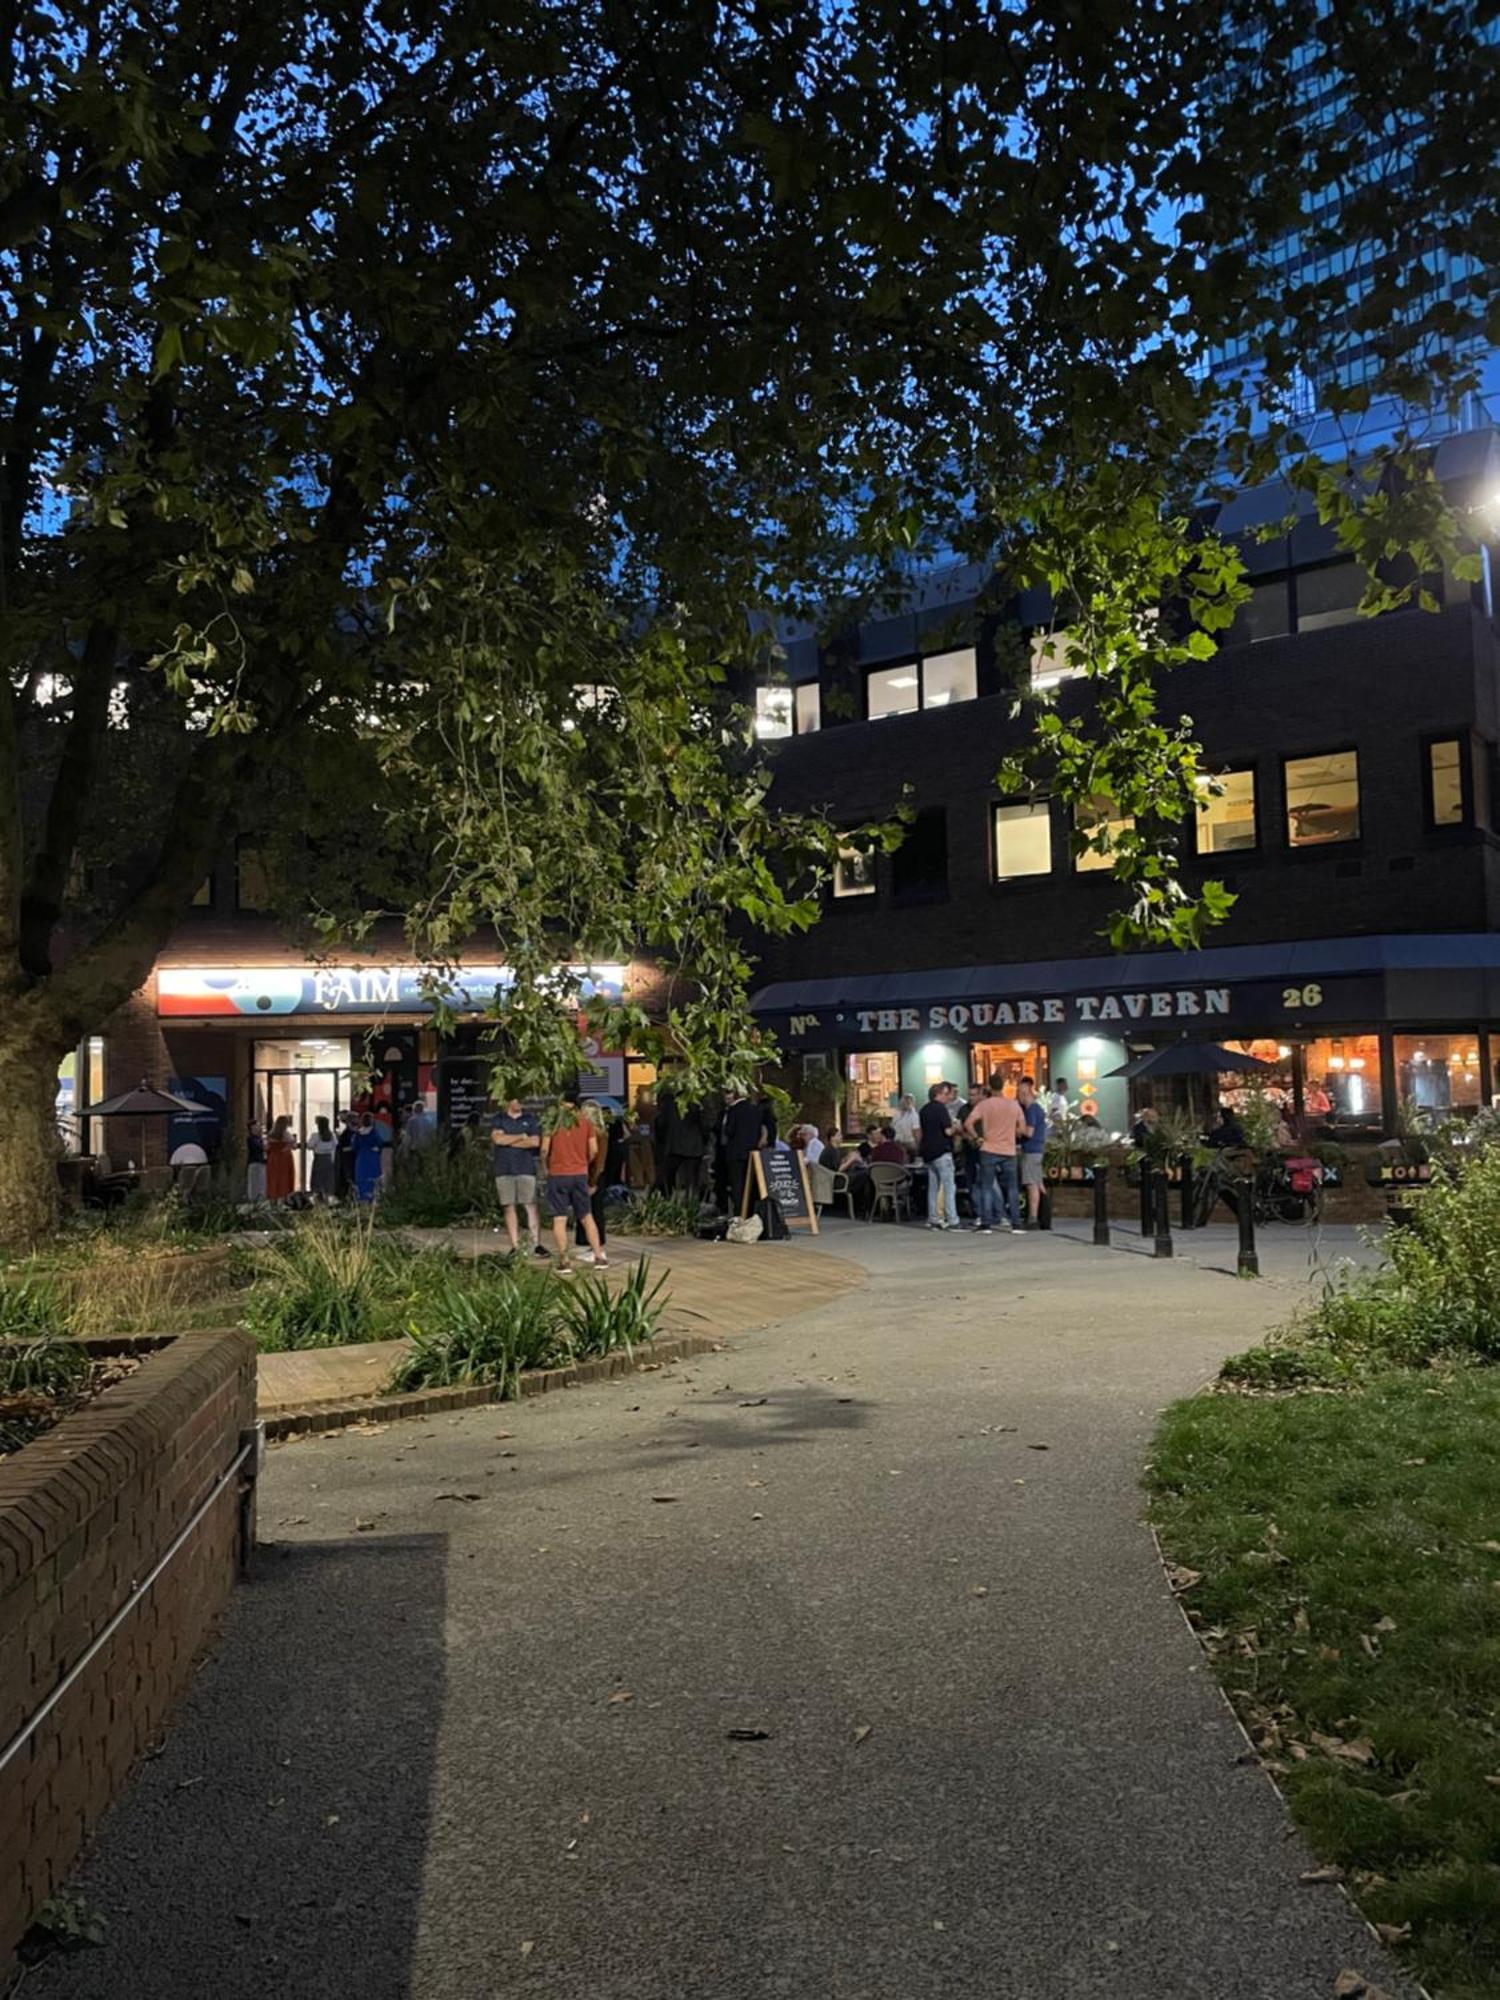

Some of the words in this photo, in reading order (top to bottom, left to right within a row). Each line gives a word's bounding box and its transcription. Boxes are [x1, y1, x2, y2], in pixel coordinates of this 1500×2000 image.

[313, 966, 400, 1010] FAIM
[1282, 983, 1323, 1008] 26
[857, 1008, 920, 1033] THE
[929, 999, 1066, 1033] SQUARE
[1076, 988, 1231, 1021] TAVERN
